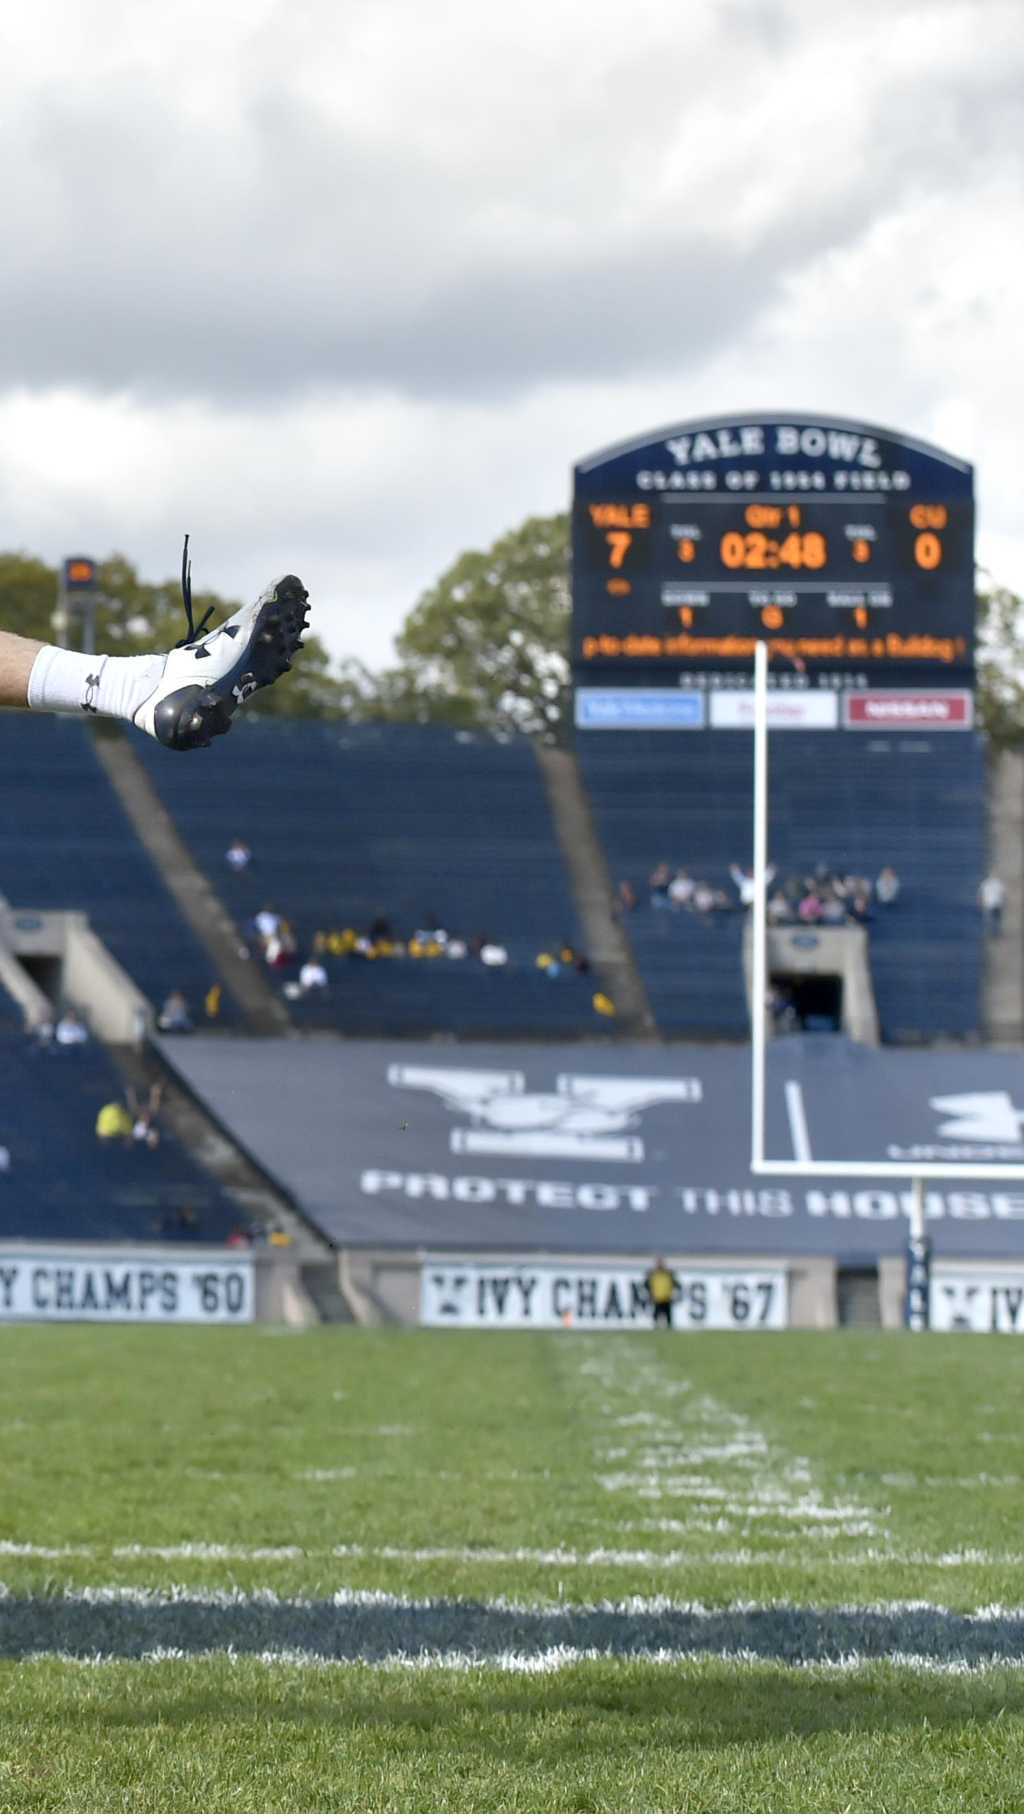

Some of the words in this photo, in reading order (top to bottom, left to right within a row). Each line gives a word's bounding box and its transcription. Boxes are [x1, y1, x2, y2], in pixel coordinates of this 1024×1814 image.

[666, 427, 765, 465] YALE
[777, 427, 881, 468] BOWL
[590, 504, 651, 528] YALE
[606, 531, 632, 568] 7
[720, 531, 826, 569] 02:48
[914, 532, 941, 570] 0
[360, 1169, 656, 1212] PROTECT
[676, 1187, 793, 1217] THIS
[31, 1268, 178, 1312] CHAMPS
[193, 1272, 246, 1315] '60
[477, 1275, 536, 1316] IVY
[722, 1281, 774, 1322] '67
